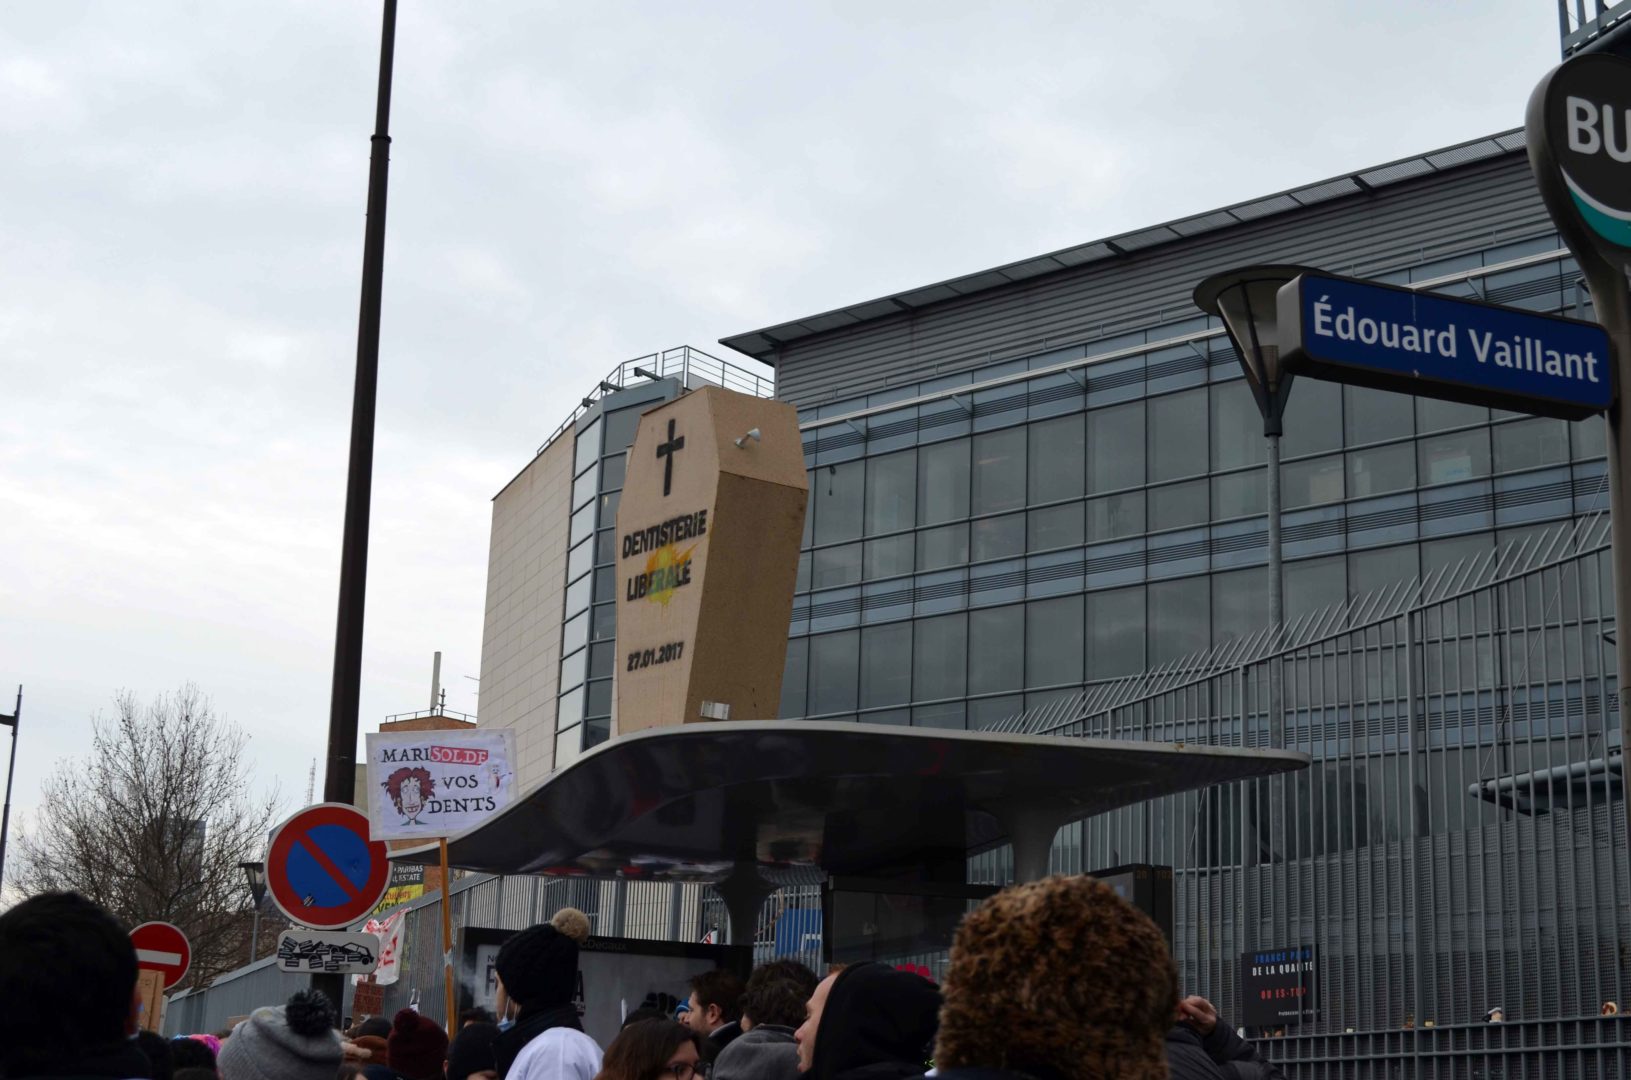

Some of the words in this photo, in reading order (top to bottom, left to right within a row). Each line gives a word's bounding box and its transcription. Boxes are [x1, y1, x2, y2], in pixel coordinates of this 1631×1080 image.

[1313, 294, 1457, 358] Édouard
[1468, 328, 1599, 383] Vaillant
[622, 509, 708, 559] DENTISTERIE
[627, 560, 691, 602] LIBERALE
[627, 641, 684, 672] 27.01.2017
[442, 774, 479, 790] VOS
[428, 796, 496, 814] DENTS
[1252, 967, 1262, 976] DE
[1265, 965, 1275, 975] LA
